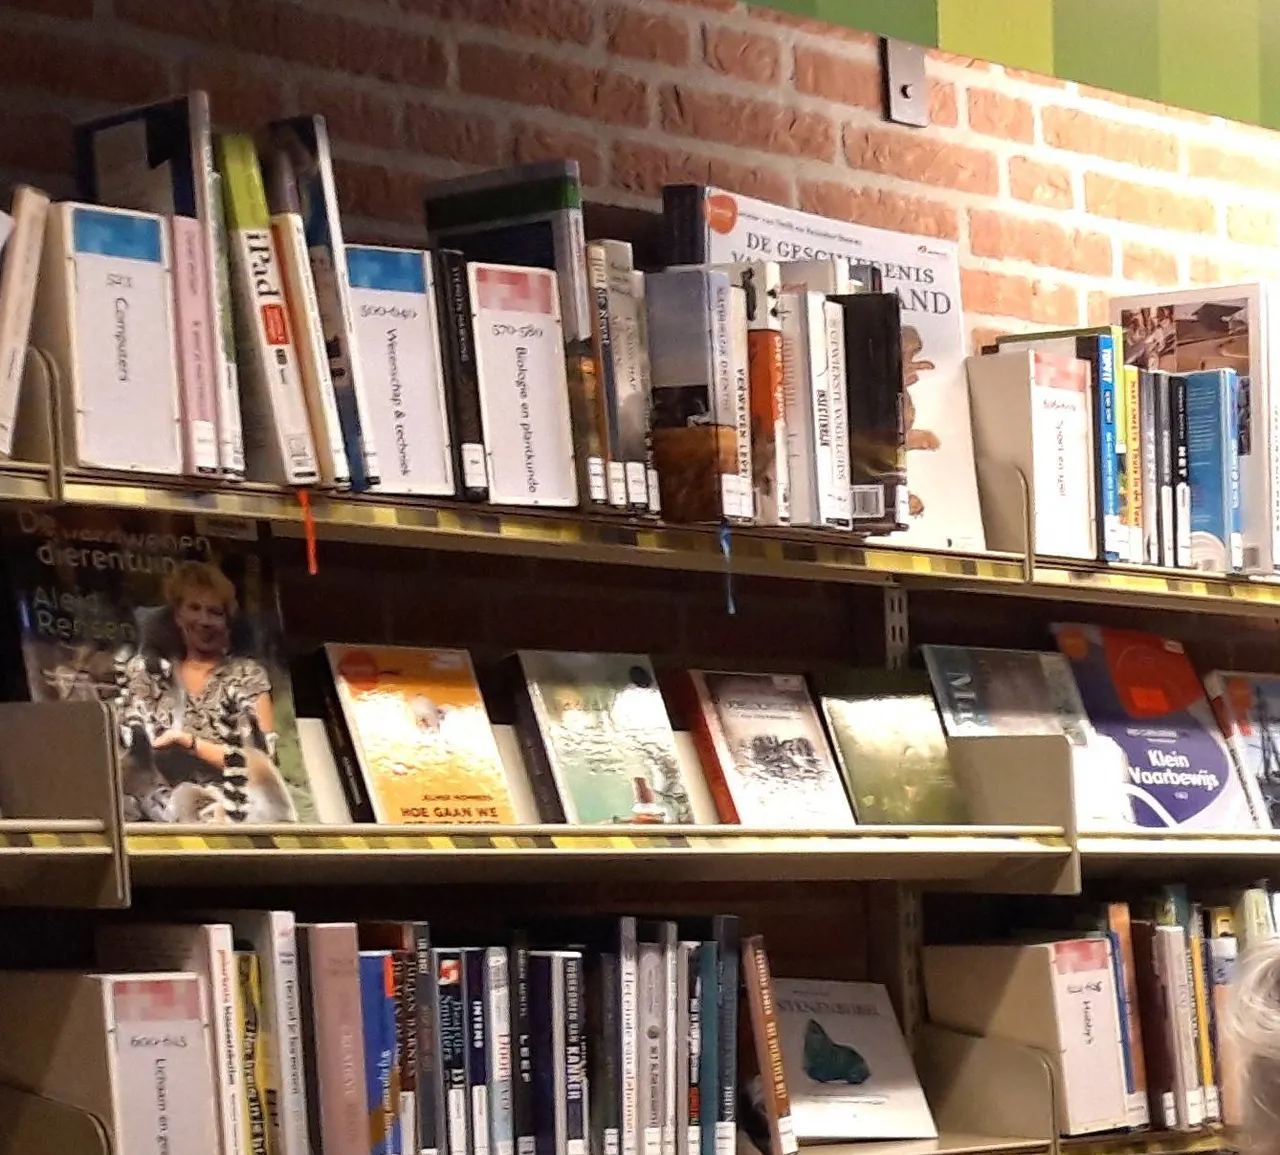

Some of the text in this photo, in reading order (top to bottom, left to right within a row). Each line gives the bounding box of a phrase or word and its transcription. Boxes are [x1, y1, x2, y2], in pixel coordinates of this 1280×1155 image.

[246, 231, 279, 299] iPad
[747, 232, 935, 284] DE GESCIEENIS
[739, 444, 749, 478] LEVE
[1128, 766, 1220, 791] Vaarbewijs
[1147, 749, 1191, 768] Klein
[472, 1000, 483, 1049] INTENS
[565, 1046, 580, 1100] KANKER
